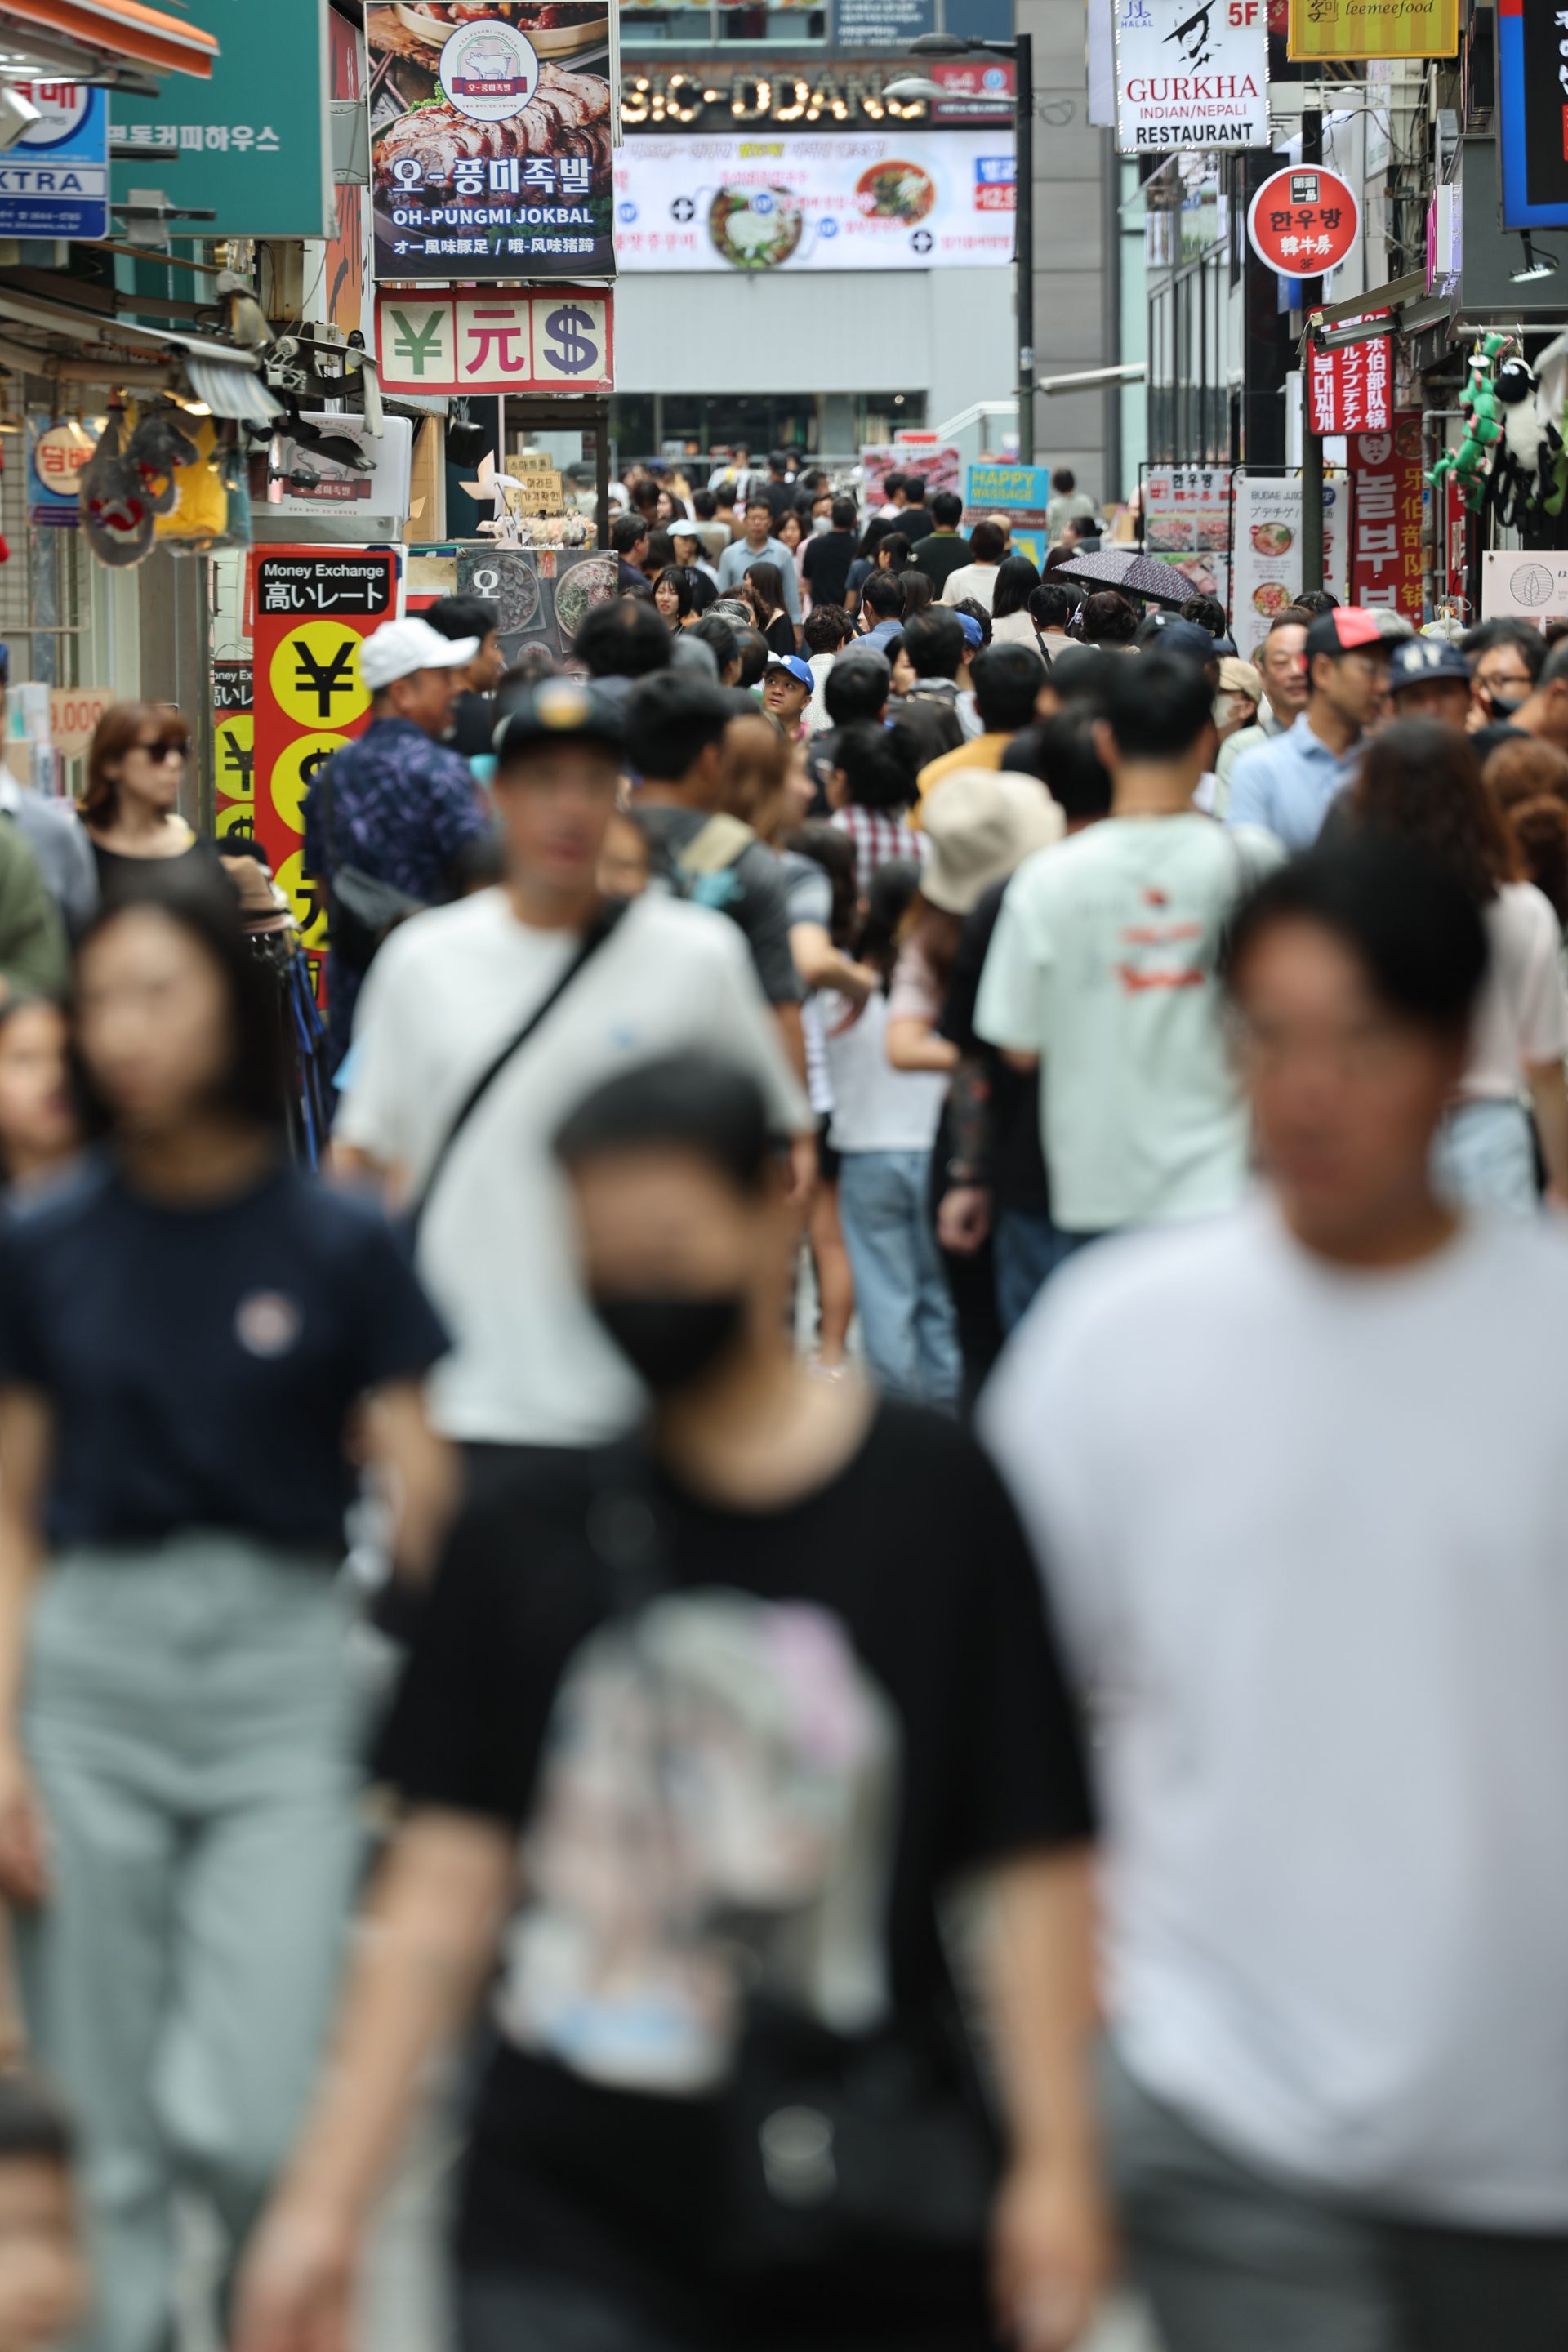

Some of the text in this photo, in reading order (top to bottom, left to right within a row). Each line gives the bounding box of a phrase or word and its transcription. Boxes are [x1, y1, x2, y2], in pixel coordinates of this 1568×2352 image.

[1227, 2, 1259, 28] 5F
[1345, 0, 1434, 19] leemeefood
[1120, 20, 1154, 29] HALAL
[1126, 74, 1259, 103] GURKHA
[1140, 104, 1247, 119] INDIAN/NEPALI
[1136, 123, 1253, 145] RESTAURANT
[391, 158, 594, 194] 오-풍미족발
[392, 207, 595, 225] OH-PUNGMI JOKBAL
[1269, 208, 1343, 232] 한우방
[389, 304, 599, 375] ¥ 元 $
[1313, 353, 1334, 432] 부대찌개
[972, 470, 1036, 485] HAPPY
[1251, 491, 1281, 501] BUDAE
[265, 564, 385, 580] Money Exchange
[265, 581, 384, 610] 高いレート
[213, 670, 237, 683] oney
[292, 641, 356, 718] ¥
